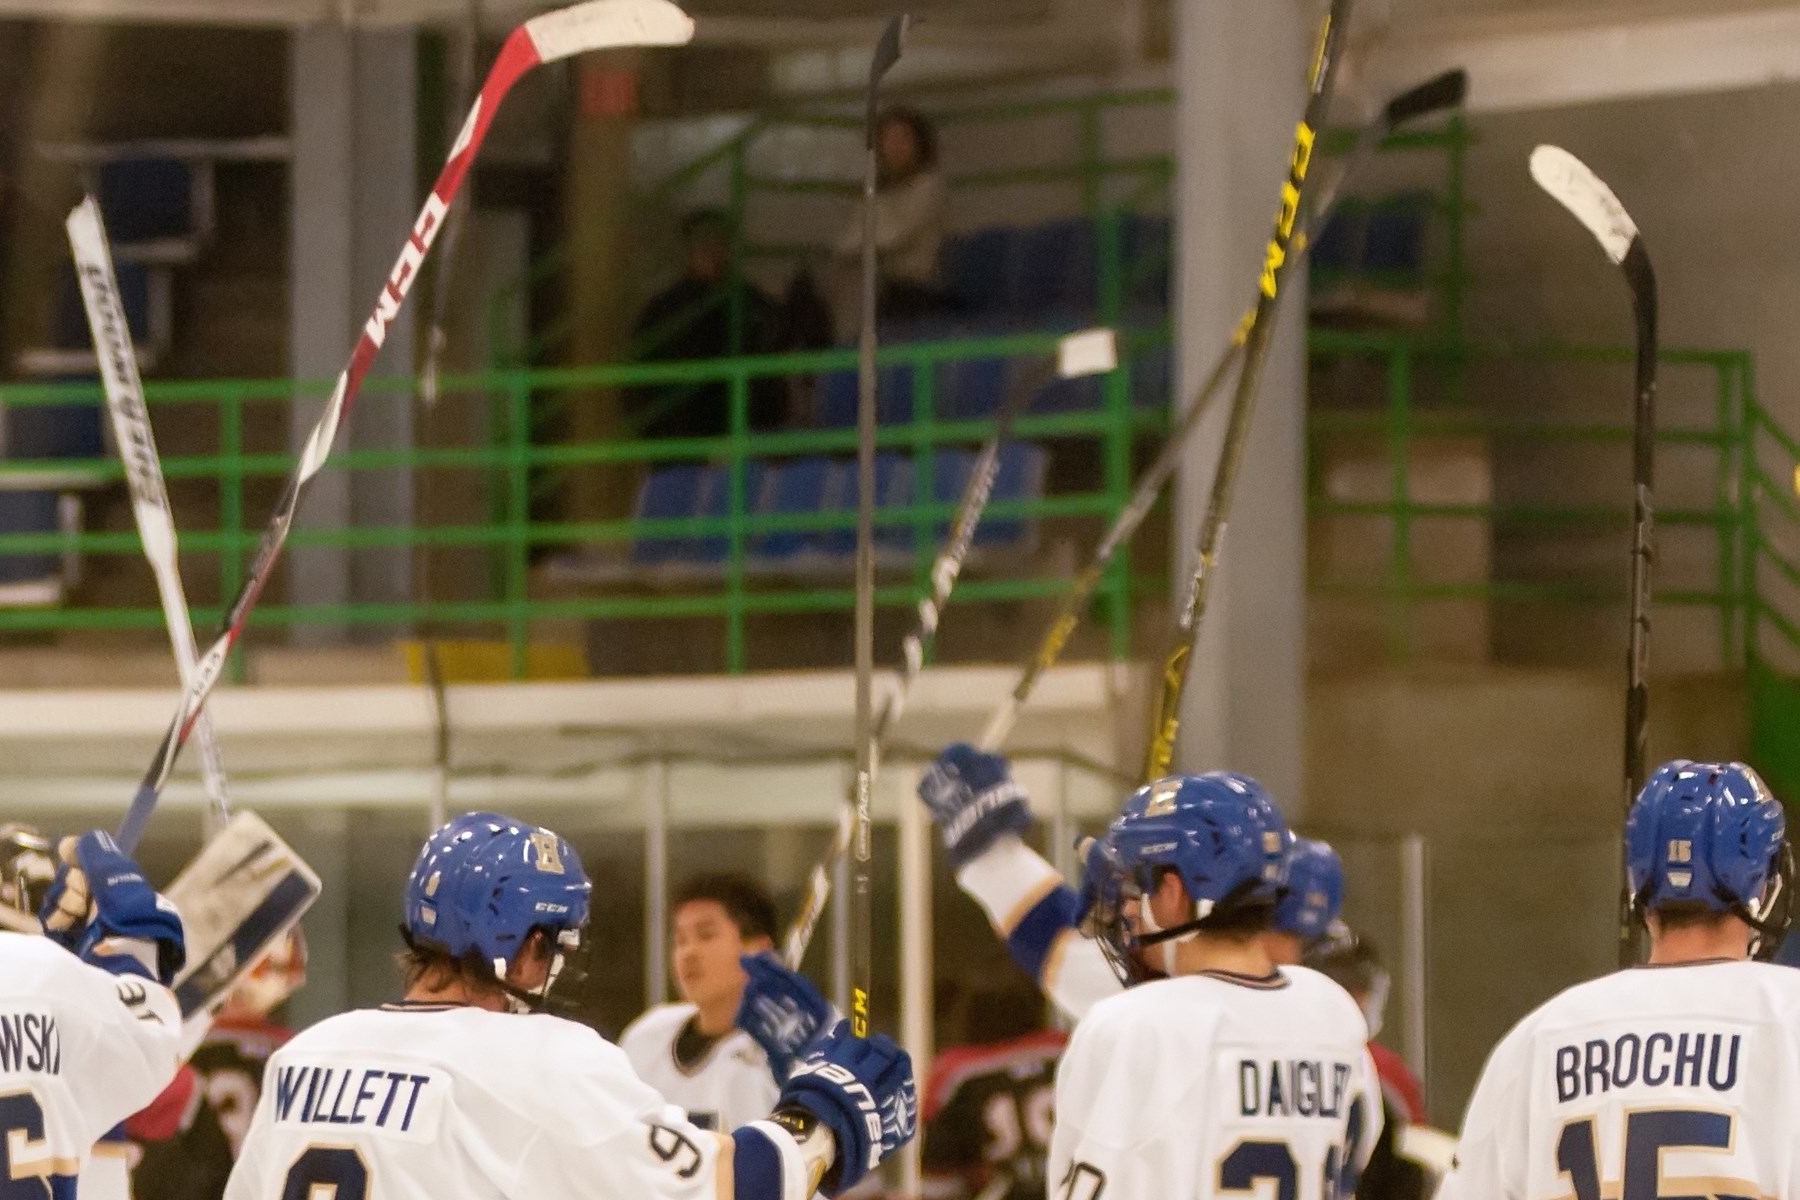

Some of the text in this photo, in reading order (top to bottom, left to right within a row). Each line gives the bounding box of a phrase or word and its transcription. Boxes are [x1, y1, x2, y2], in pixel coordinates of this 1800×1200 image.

[365, 191, 450, 348] CCM
[530, 832, 565, 875] H
[275, 1066, 431, 1132] WILLETT
[1556, 1032, 1741, 1103] BROCHU
[649, 1124, 702, 1178] 9
